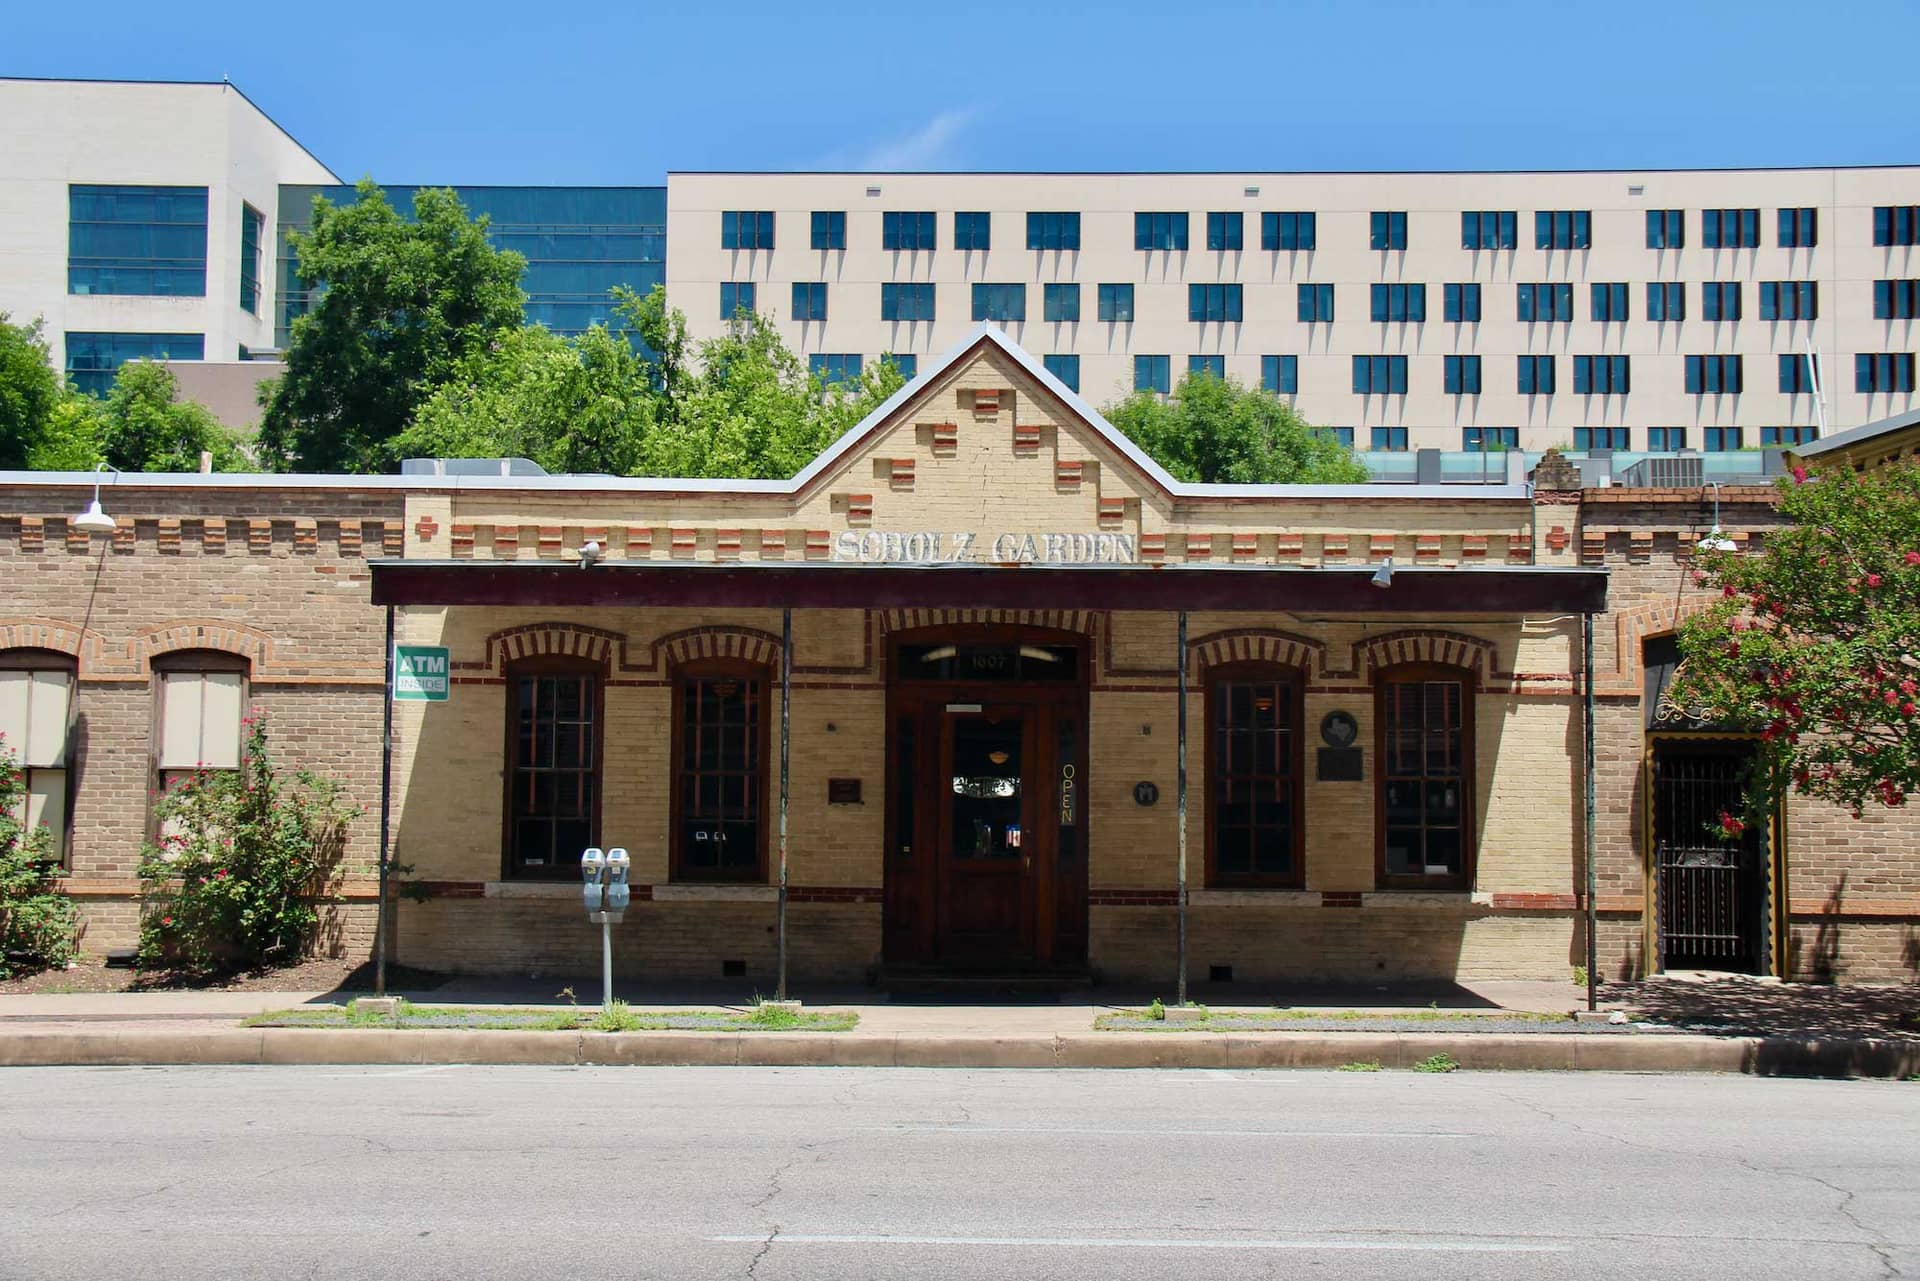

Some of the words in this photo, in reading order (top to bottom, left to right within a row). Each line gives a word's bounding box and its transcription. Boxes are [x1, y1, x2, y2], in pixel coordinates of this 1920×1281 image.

[833, 531, 977, 563] SCHOLZ
[992, 531, 1136, 563] GARDEN
[400, 655, 445, 673] ATM
[400, 678, 442, 689] INSIDE
[1062, 763, 1075, 824] OPEN
